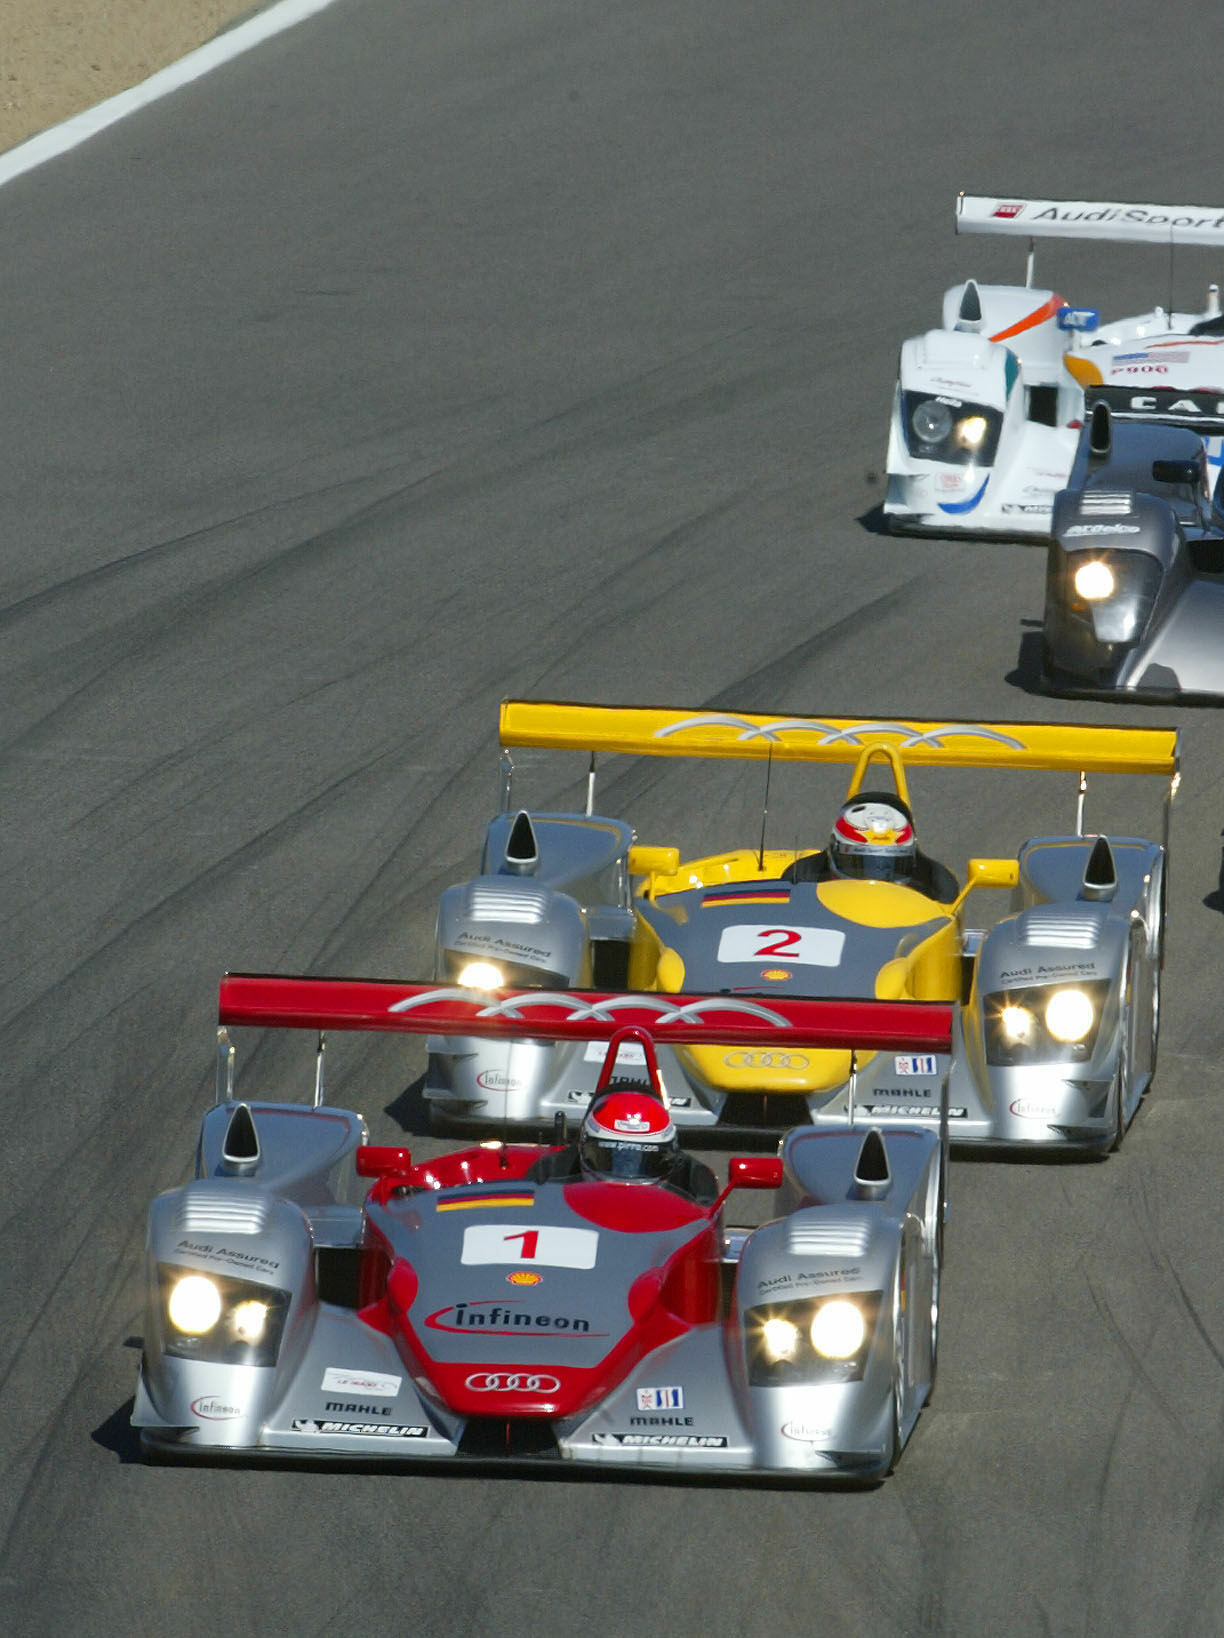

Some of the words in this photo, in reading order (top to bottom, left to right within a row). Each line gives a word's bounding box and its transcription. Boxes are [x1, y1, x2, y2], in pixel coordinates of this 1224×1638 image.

[458, 932, 491, 942] Audi
[494, 939, 551, 958] Assured
[754, 928, 802, 957] 2
[1000, 968, 1032, 978] Audi
[1038, 962, 1095, 973] Assured
[873, 1088, 932, 1098] MAHLE
[871, 1104, 965, 1117] MICHELN
[504, 1230, 539, 1259] 1
[177, 1240, 214, 1253] Audi
[216, 1248, 280, 1269] Assured
[758, 1274, 792, 1288] Audi
[798, 1267, 861, 1280] Assured
[325, 1401, 393, 1416] MAHLE
[320, 1421, 424, 1436] MICHELIN
[630, 1416, 694, 1426] MAHLE
[622, 1434, 723, 1447] MICHELIN
